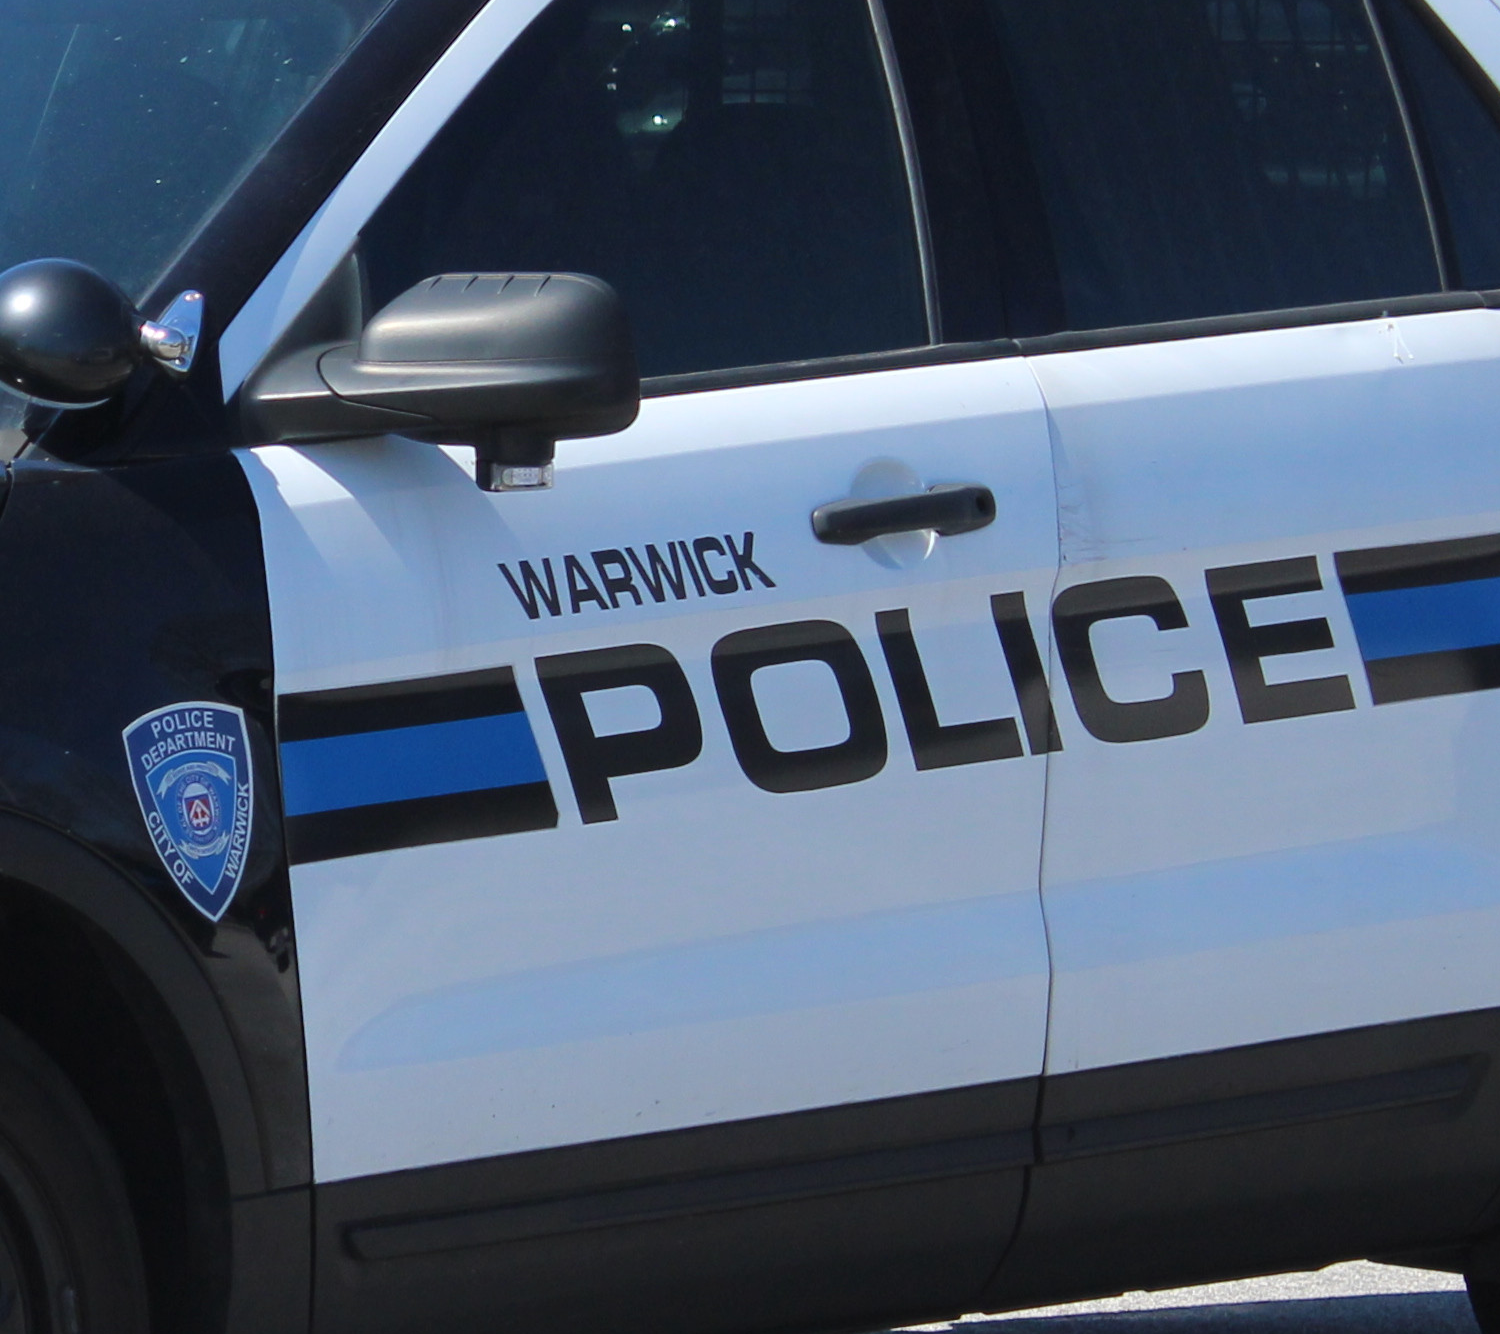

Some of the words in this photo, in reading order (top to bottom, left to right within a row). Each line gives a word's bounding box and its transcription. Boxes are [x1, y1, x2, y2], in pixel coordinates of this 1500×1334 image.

[496, 529, 778, 621] WARWICK
[150, 710, 214, 739] POLICE
[532, 554, 1357, 827] POLICE
[140, 731, 236, 771] DEPARTMENT
[149, 811, 176, 858] CITY
[173, 859, 194, 885] OF
[224, 782, 250, 880] WARWICK
